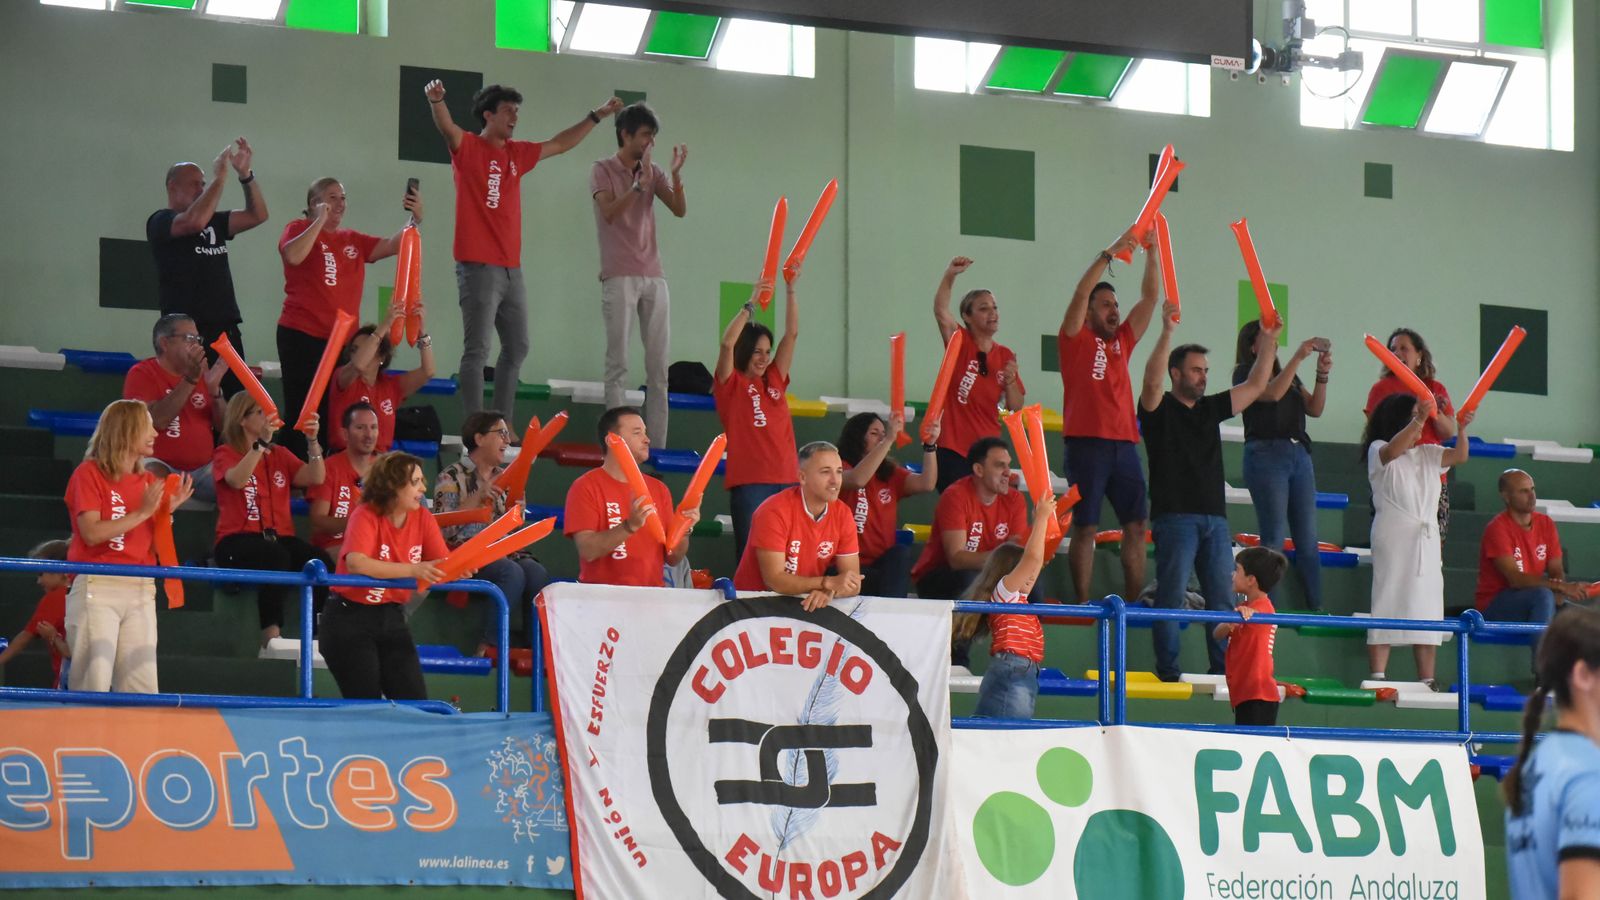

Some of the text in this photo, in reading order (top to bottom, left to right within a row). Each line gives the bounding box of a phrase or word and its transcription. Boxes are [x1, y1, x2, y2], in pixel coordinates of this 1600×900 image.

[587, 626, 620, 737] ESFUERZO
[692, 626, 873, 704] COLEGIO
[0, 736, 458, 861] eportes
[1194, 749, 1456, 857] FABM
[419, 855, 510, 870] www.lalinea.es
[725, 830, 902, 900] EUROPA
[1206, 870, 1459, 900] Federación Andaluza
